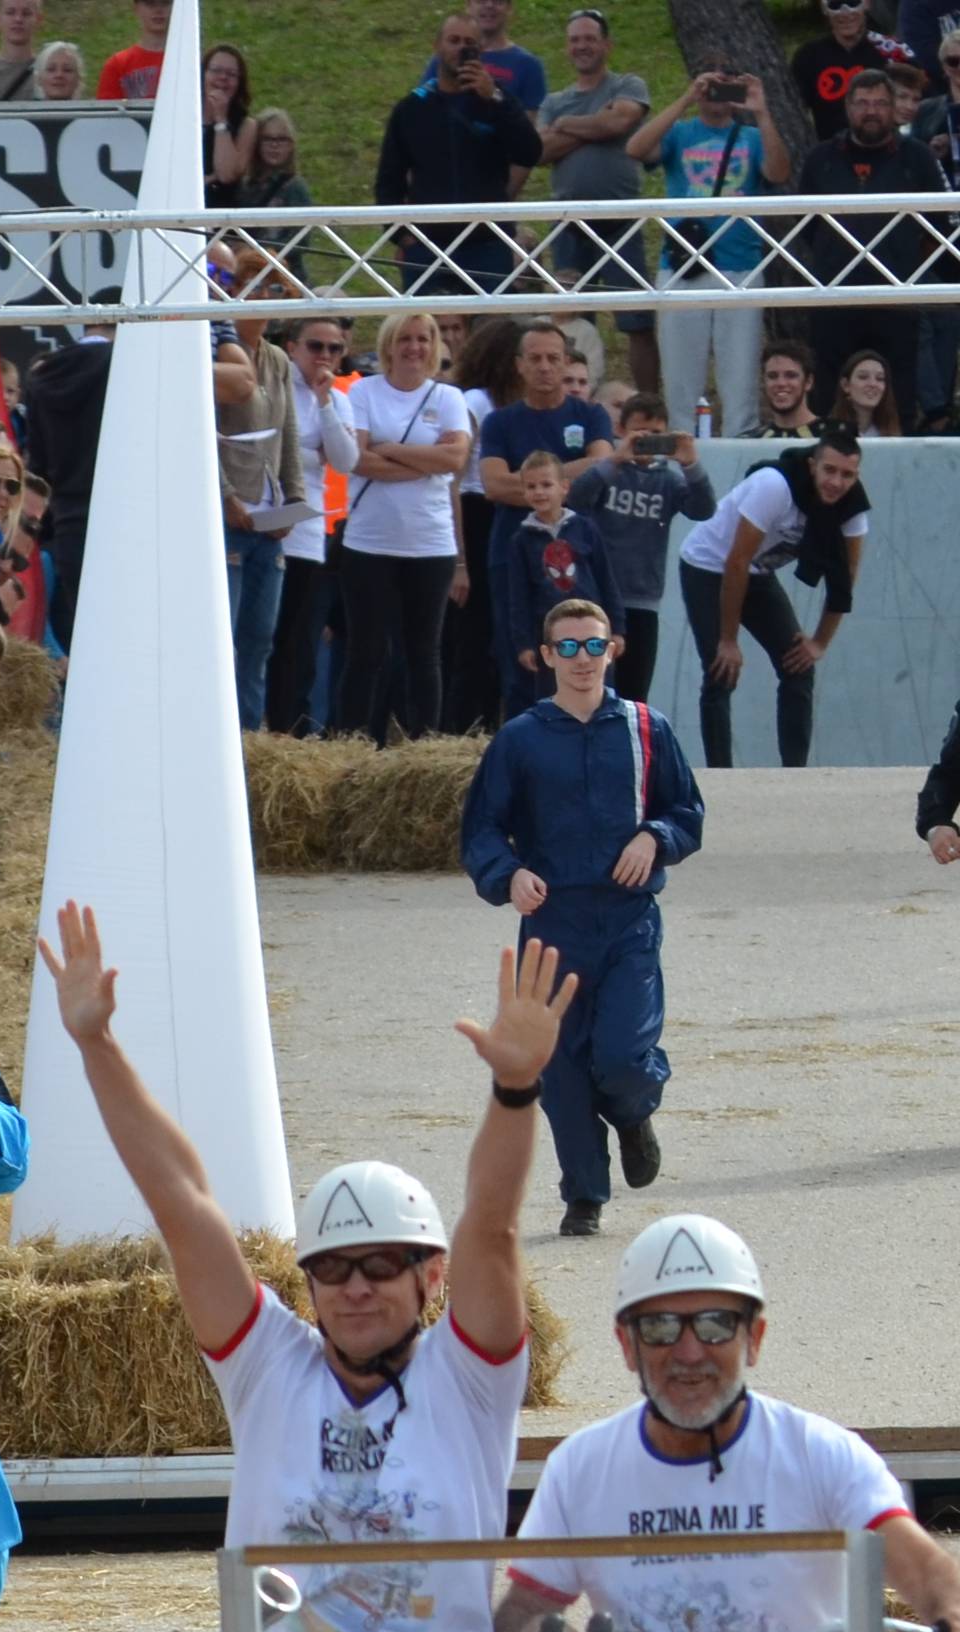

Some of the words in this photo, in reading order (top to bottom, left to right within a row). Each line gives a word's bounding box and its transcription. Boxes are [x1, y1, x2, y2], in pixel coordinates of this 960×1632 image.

[604, 485, 664, 519] 1952
[664, 1264, 707, 1276] CAMP
[629, 1505, 702, 1535] BRZINA
[709, 1504, 737, 1530] MI
[744, 1503, 765, 1529] JE
